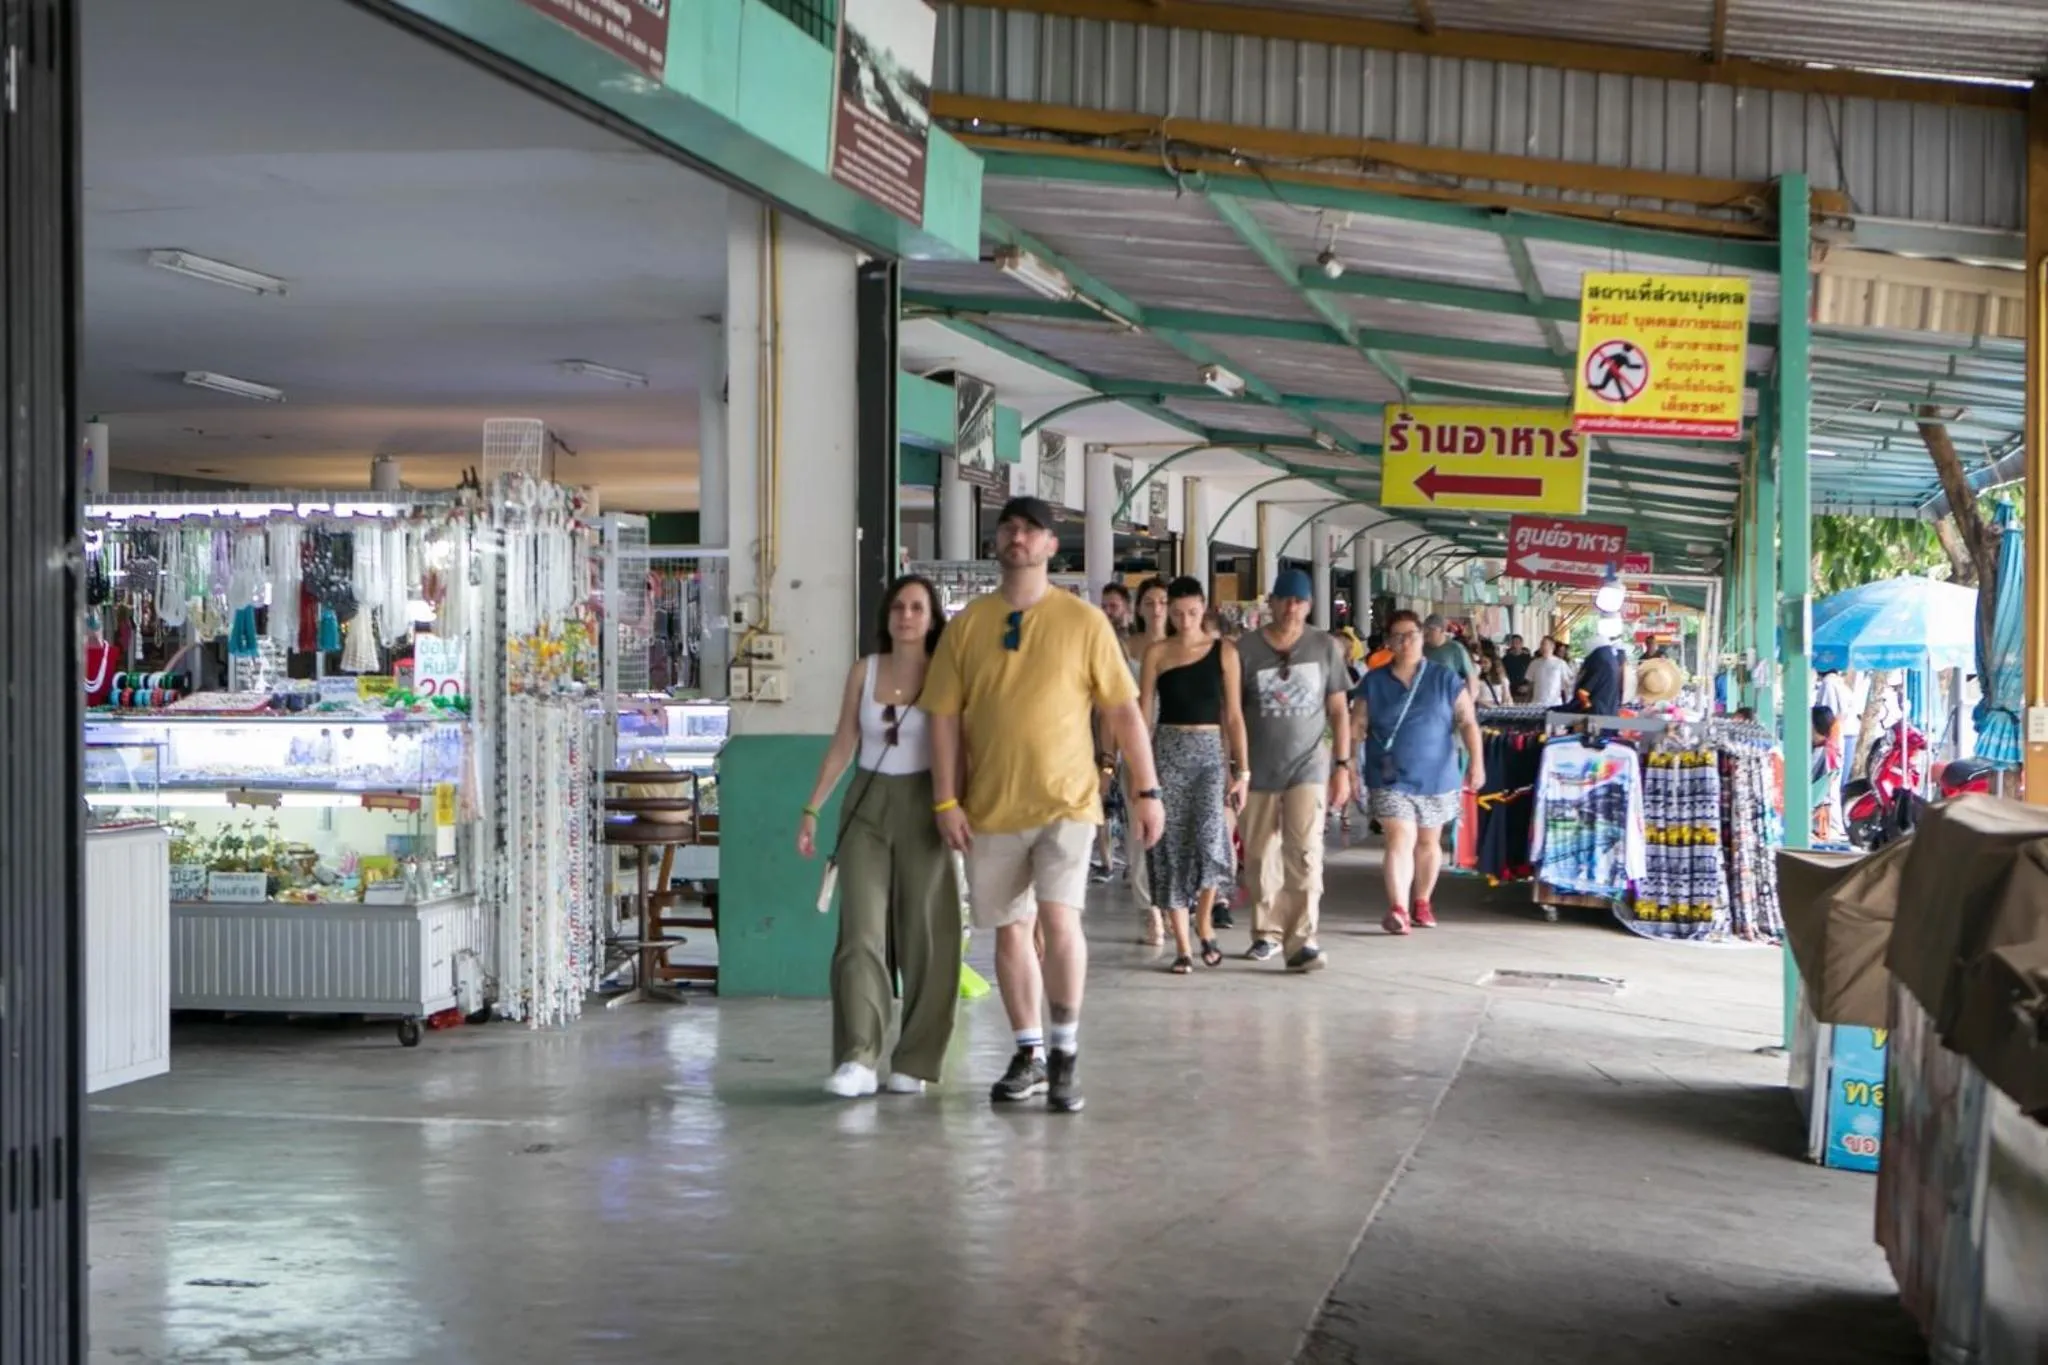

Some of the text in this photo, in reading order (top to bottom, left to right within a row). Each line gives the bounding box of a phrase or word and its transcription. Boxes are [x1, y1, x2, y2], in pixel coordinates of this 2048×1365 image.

[1587, 278, 1745, 309] สถานที่ส่วนบุคคล
[1388, 412, 1580, 459] ร้านอาหาร
[1515, 522, 1623, 553] ศูนย์อาหาร
